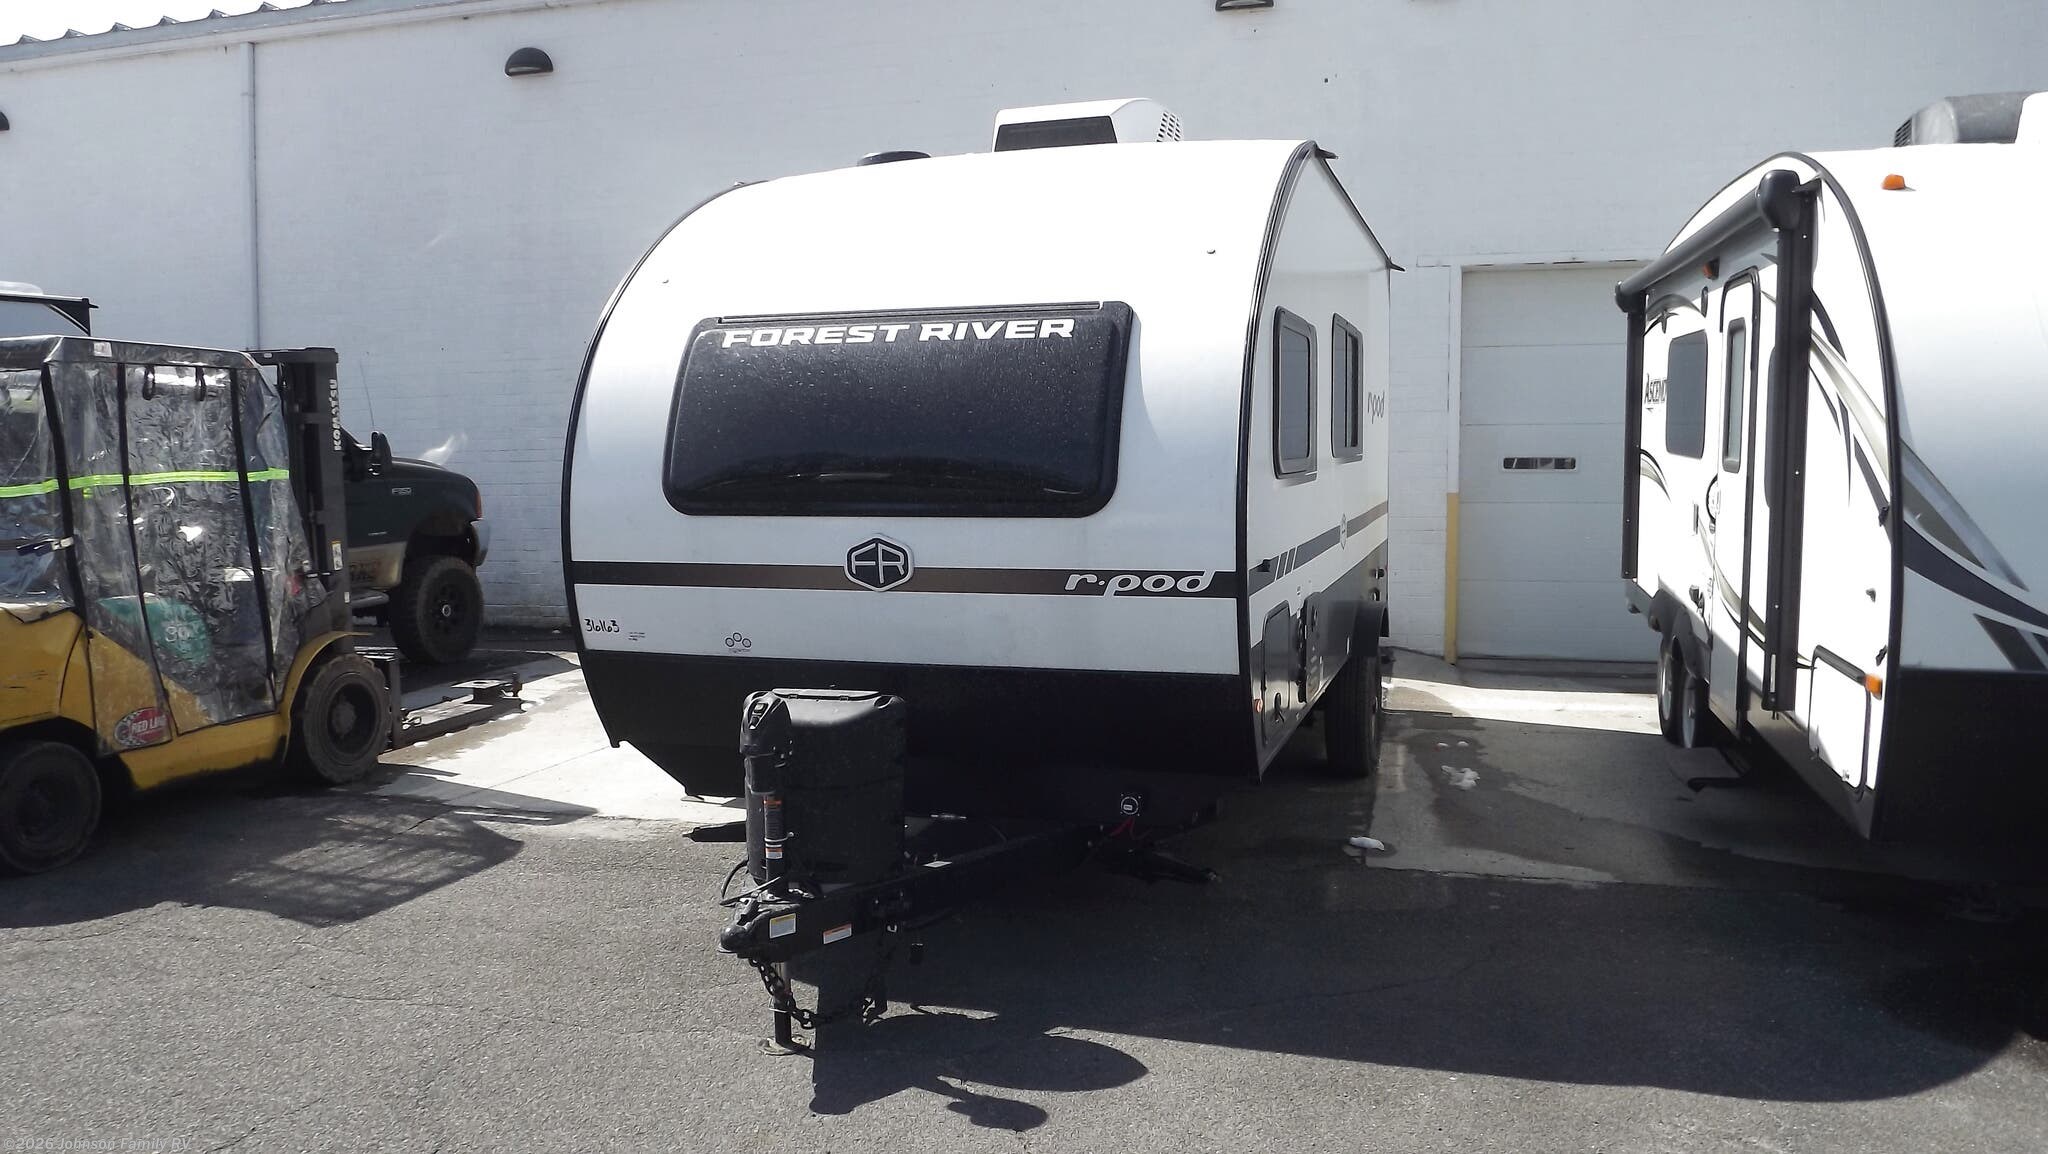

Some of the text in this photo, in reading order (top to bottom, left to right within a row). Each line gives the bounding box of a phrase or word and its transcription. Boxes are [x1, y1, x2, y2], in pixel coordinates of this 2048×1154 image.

[722, 319, 1075, 349] FOREST RIVER
[329, 378, 343, 452] KOMATSU
